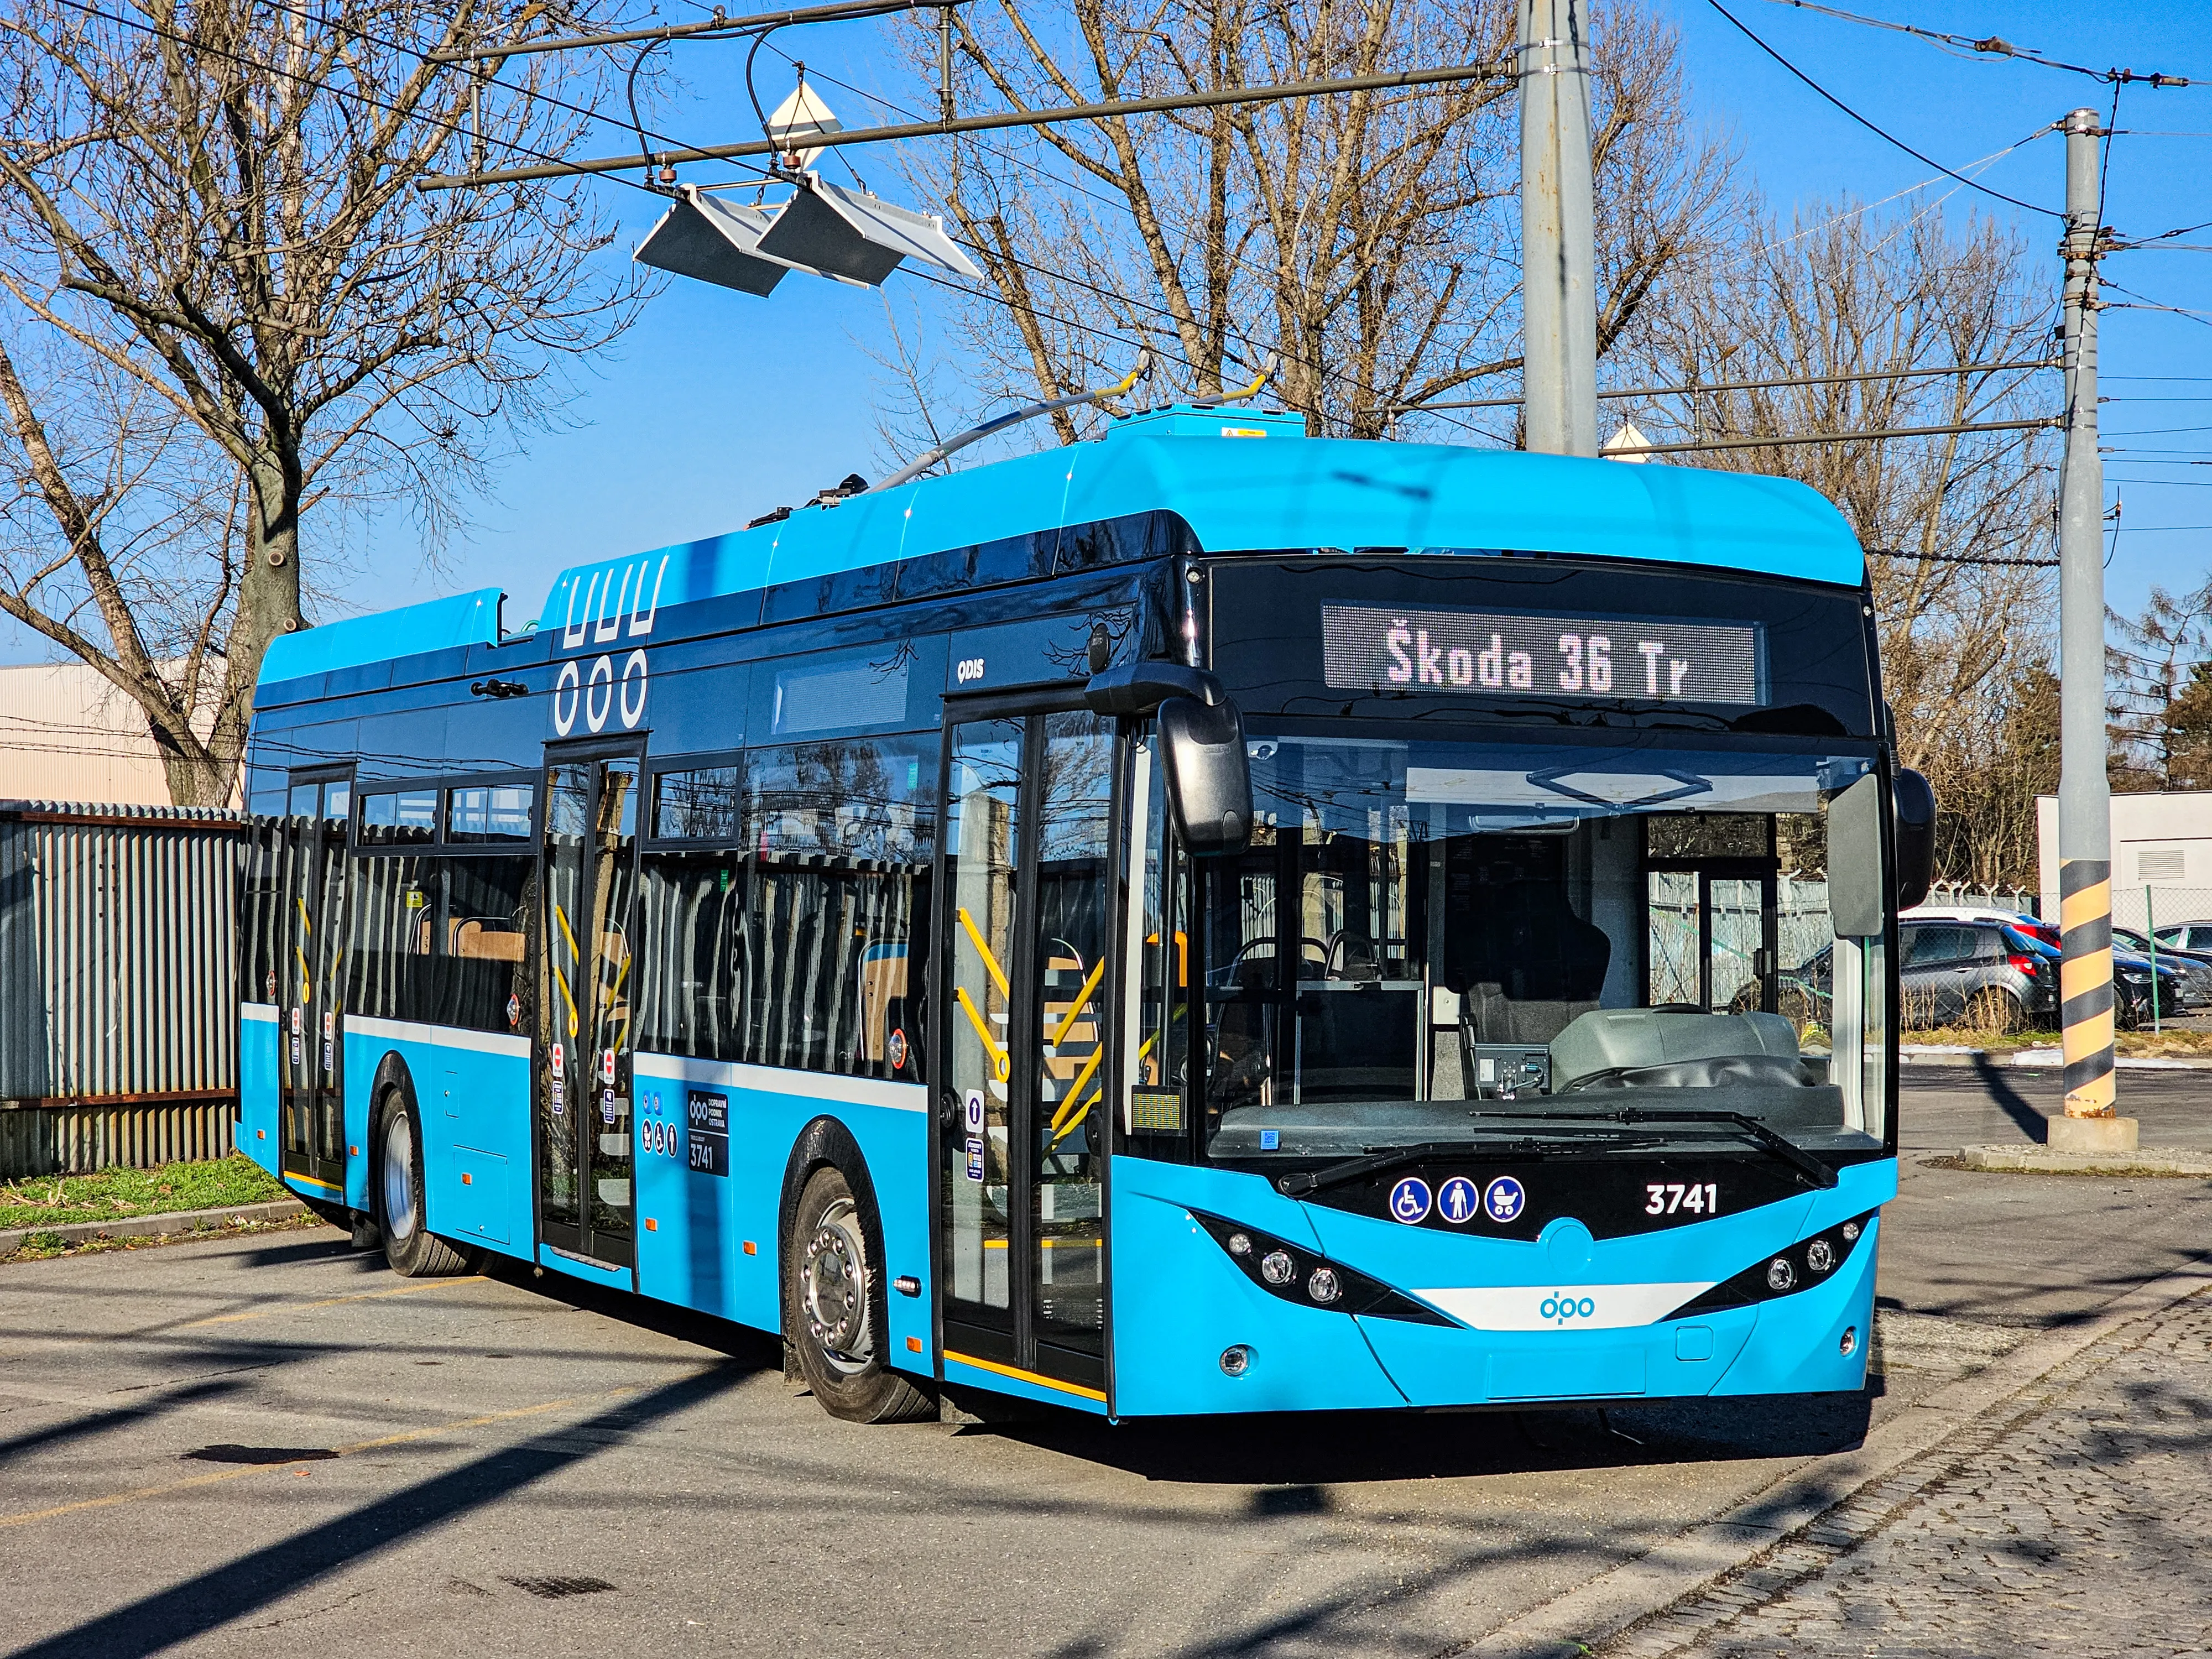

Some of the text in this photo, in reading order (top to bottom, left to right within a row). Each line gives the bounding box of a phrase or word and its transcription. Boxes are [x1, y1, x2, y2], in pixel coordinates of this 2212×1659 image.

[1387, 619, 1688, 695] Škoda 36 Tr
[957, 658, 984, 685] ODIS
[708, 1118, 726, 1128] OSTRAVA
[691, 1143, 713, 1170] 3741
[1645, 1183, 1717, 1215] 3741
